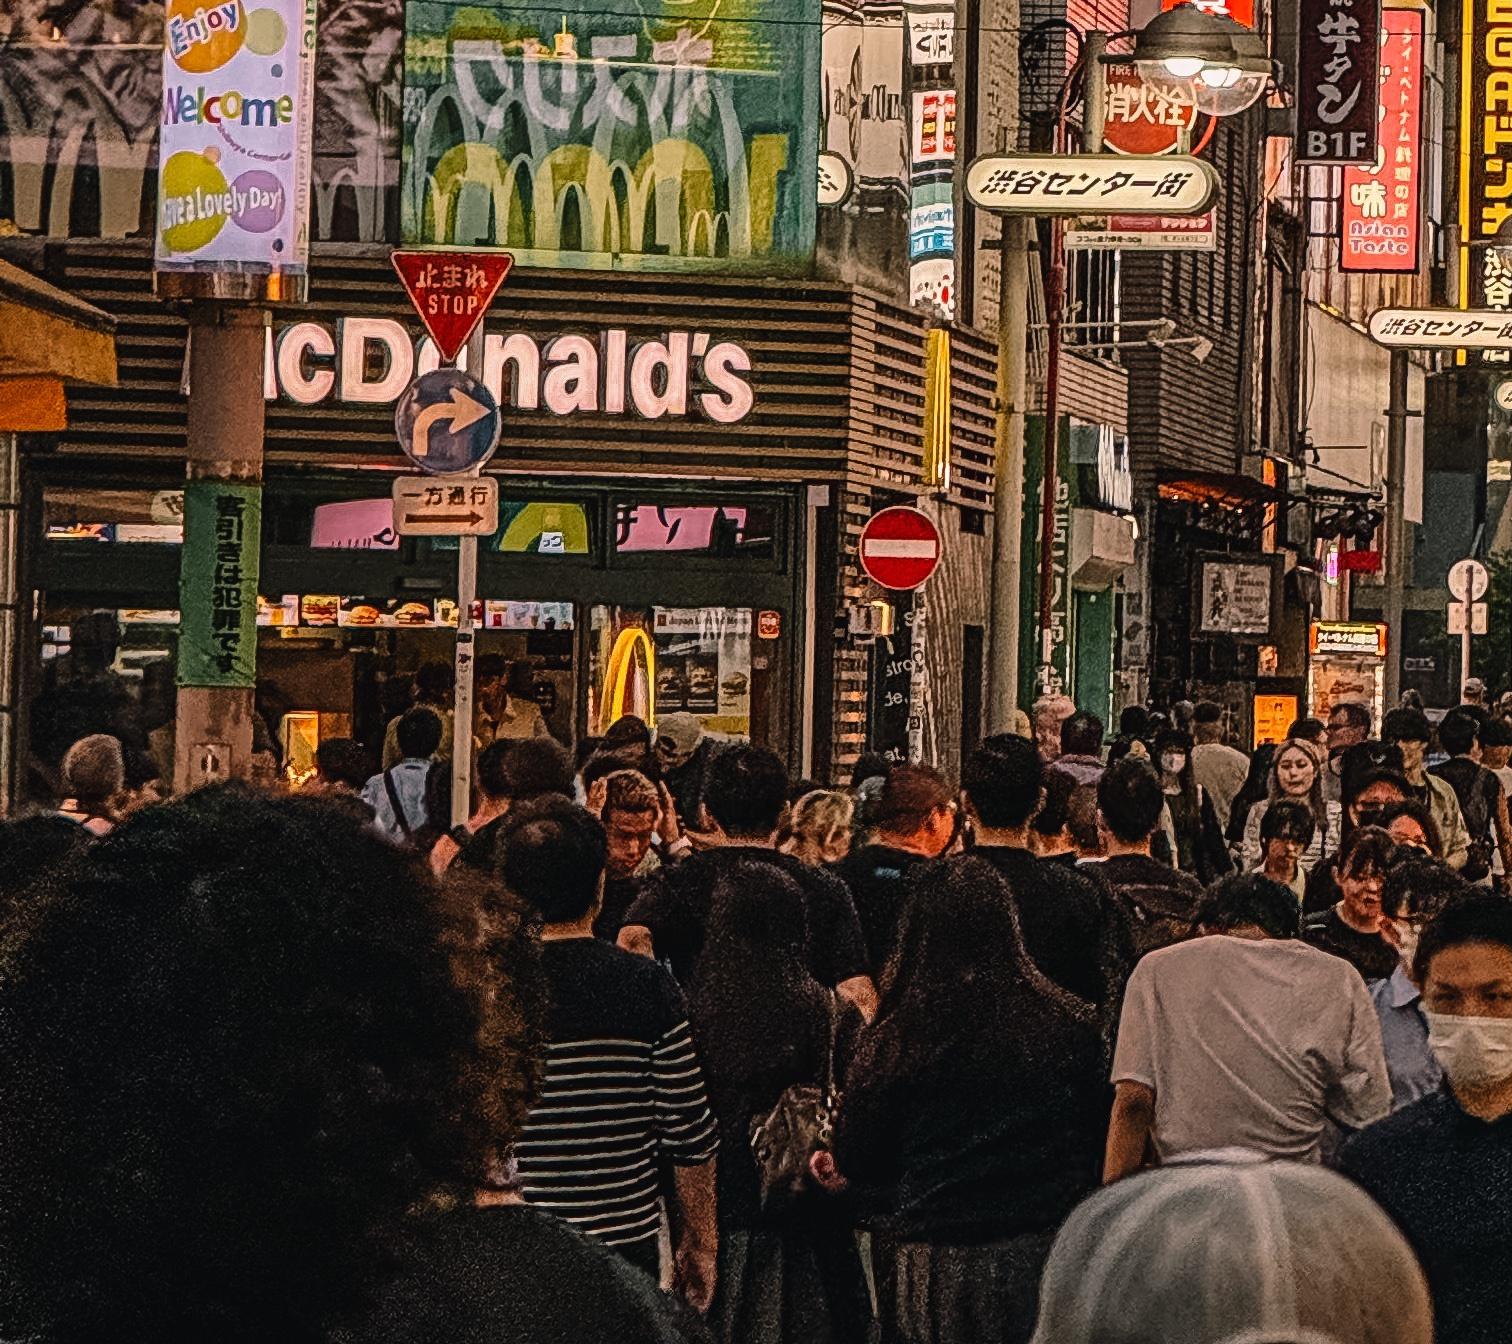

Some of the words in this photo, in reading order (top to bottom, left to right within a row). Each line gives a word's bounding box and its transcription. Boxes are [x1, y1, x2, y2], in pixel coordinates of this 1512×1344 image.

[168, 0, 240, 59] Enjoy
[1316, 10, 1363, 125] 牛タン
[163, 86, 294, 128] Welcome
[1103, 82, 1192, 126] 消火栓
[1306, 129, 1369, 159] B1F
[980, 168, 1194, 198] 渋谷センター街
[196, 177, 246, 220] Lovely
[1348, 219, 1410, 239] Asian
[1349, 238, 1410, 255] Taste
[414, 264, 489, 292] 止まれ
[427, 293, 478, 316] STOP
[401, 485, 490, 509] 一方通行
